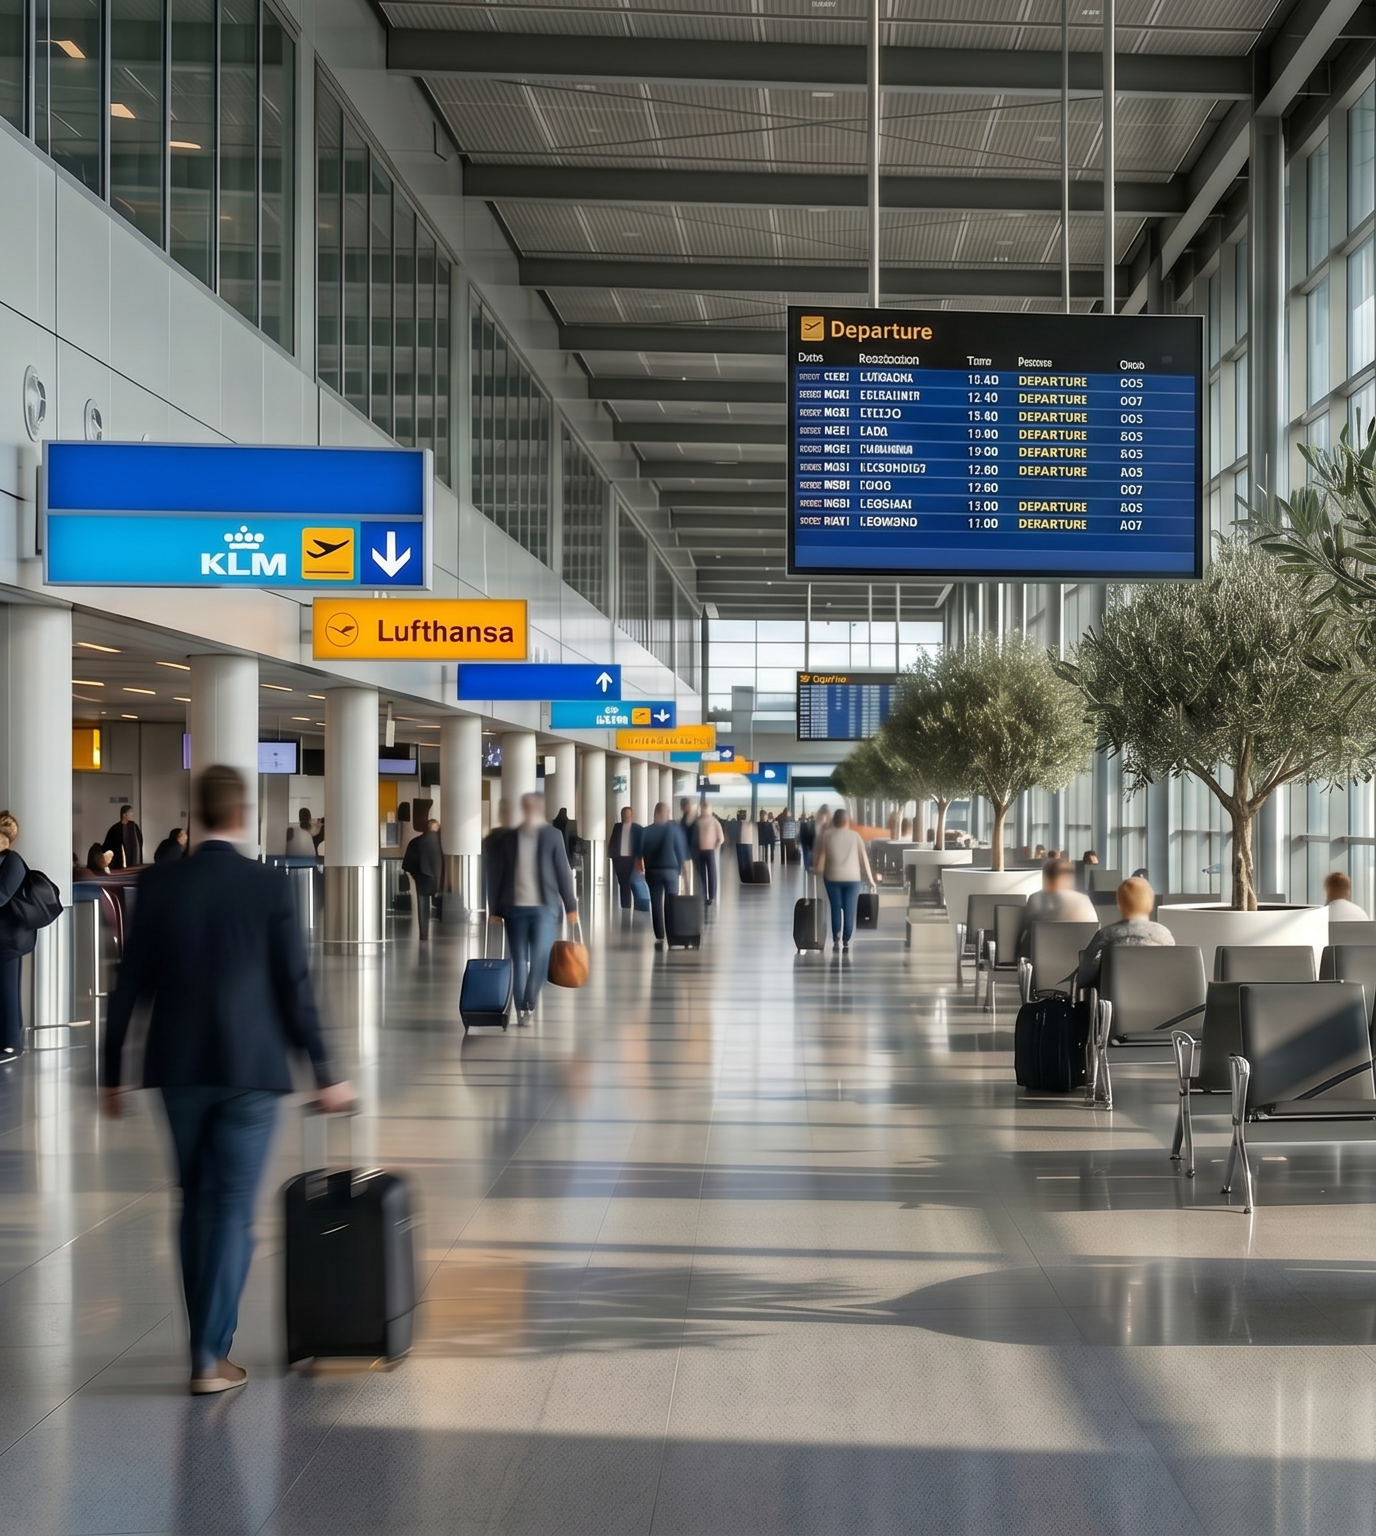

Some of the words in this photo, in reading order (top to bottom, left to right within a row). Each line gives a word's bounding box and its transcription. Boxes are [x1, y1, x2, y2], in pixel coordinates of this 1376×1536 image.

[831, 320, 933, 343] Departure
[1018, 376, 1088, 386] DEPARTURE
[968, 391, 999, 402] 12.40
[1018, 393, 1088, 404] DEPARTURE
[1018, 411, 1088, 422] DEPARTURE
[1018, 429, 1088, 440] DEPARTURE
[1018, 466, 1088, 476] DEPARTURE
[1018, 502, 1088, 512] DEPARTURE
[201, 552, 287, 576] KLM
[378, 619, 514, 643] Lufthansa
